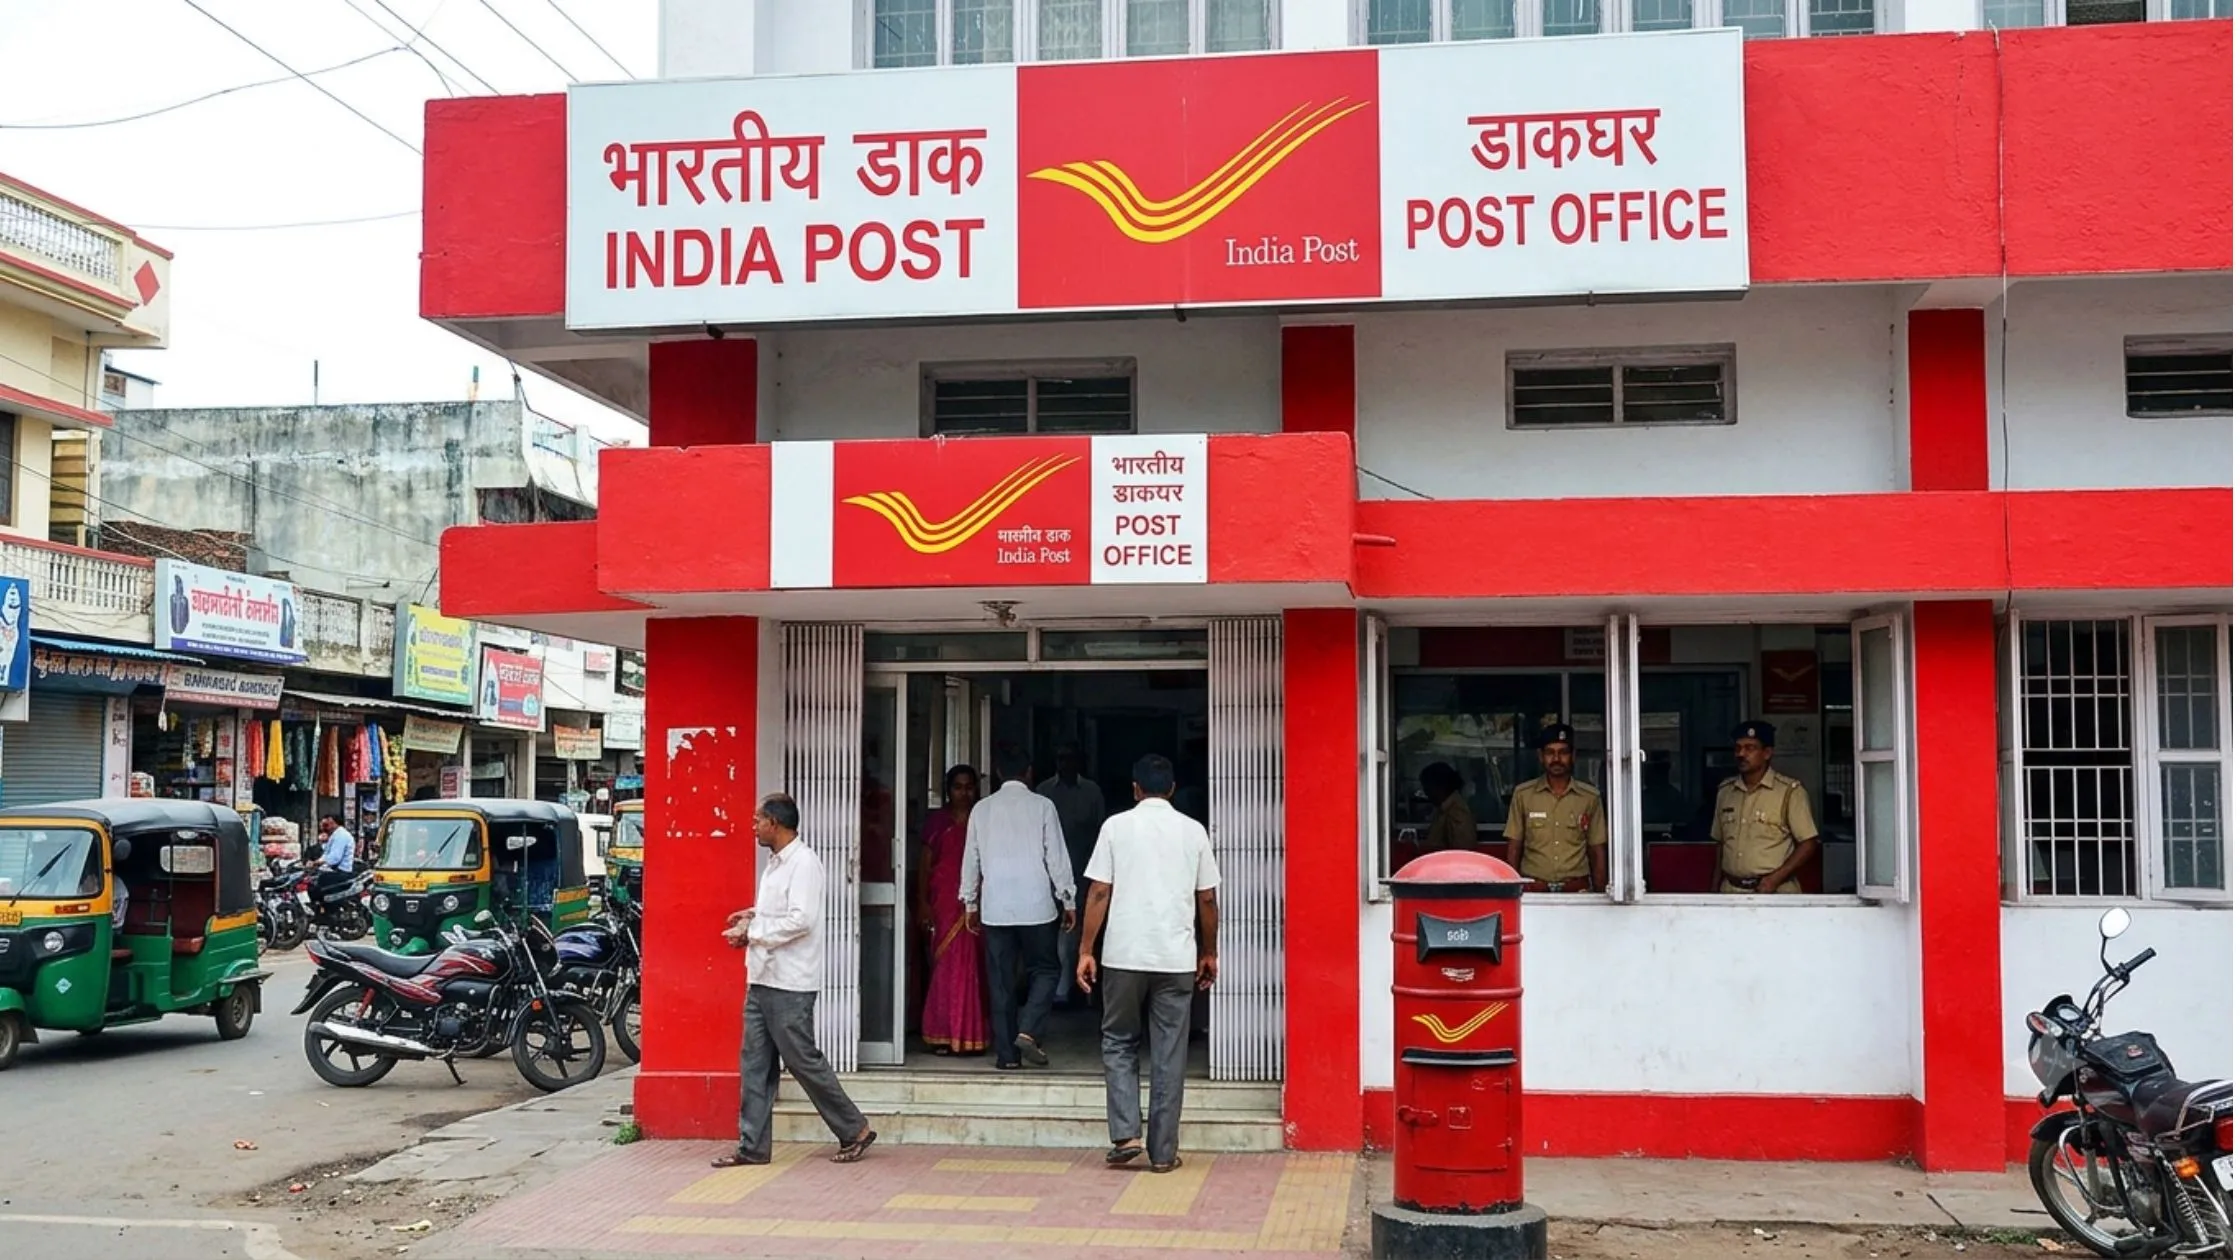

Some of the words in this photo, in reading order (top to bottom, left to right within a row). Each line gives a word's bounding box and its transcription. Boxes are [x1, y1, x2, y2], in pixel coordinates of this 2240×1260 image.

[1468, 108, 1661, 171] डाकघर
[604, 111, 825, 206] भारतीय
[853, 128, 988, 197] डाक
[1407, 194, 1534, 249] POST
[1551, 187, 1729, 245] OFFICE
[607, 227, 783, 289] INDIA
[805, 218, 985, 283] POST
[1226, 237, 1294, 266] India
[1303, 236, 1360, 265] Post
[1111, 450, 1185, 475] भारतीय
[1115, 515, 1181, 536] POST
[997, 547, 1036, 564] India
[1040, 546, 1072, 564] Post
[1103, 544, 1193, 566] OFFICE
